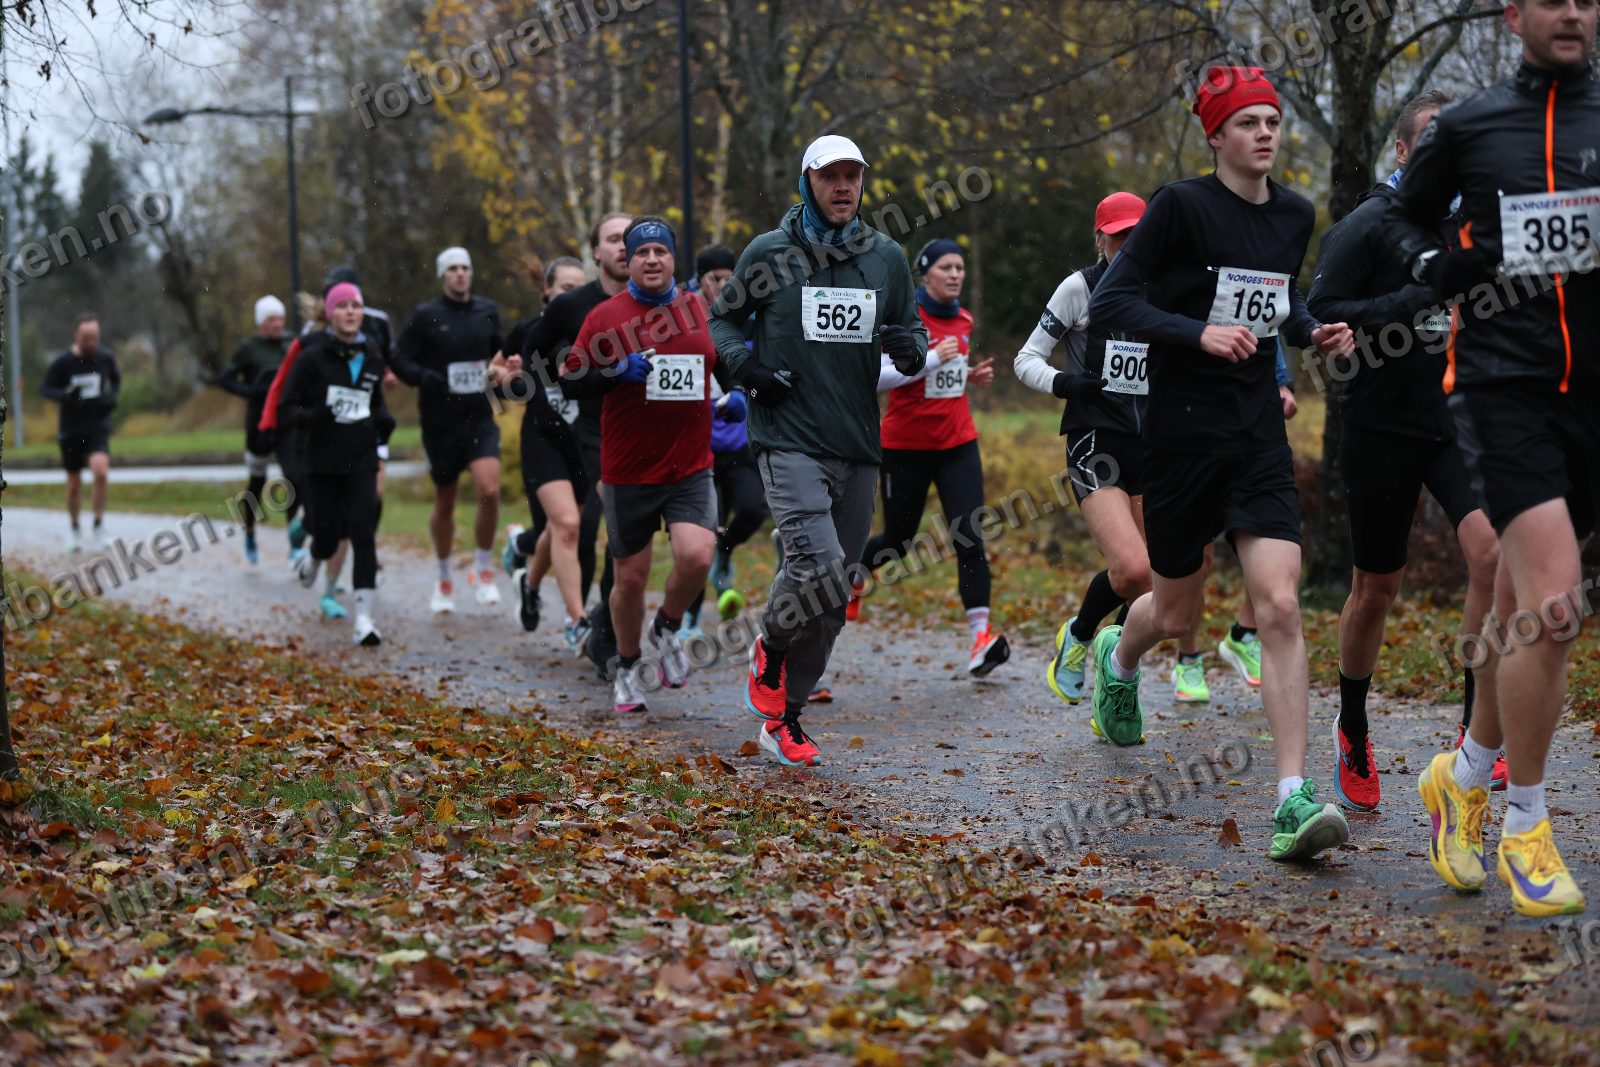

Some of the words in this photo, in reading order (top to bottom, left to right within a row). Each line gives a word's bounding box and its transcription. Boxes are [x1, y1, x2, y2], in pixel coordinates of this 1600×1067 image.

[1523, 214, 1590, 255] 385
[1227, 273, 1286, 287] NORGESTESTEN
[831, 290, 857, 299] Aurskog
[1233, 288, 1277, 323] 165
[816, 303, 862, 331] 562
[659, 368, 694, 390] 824
[936, 368, 963, 389] 664
[1110, 354, 1148, 382] 900
